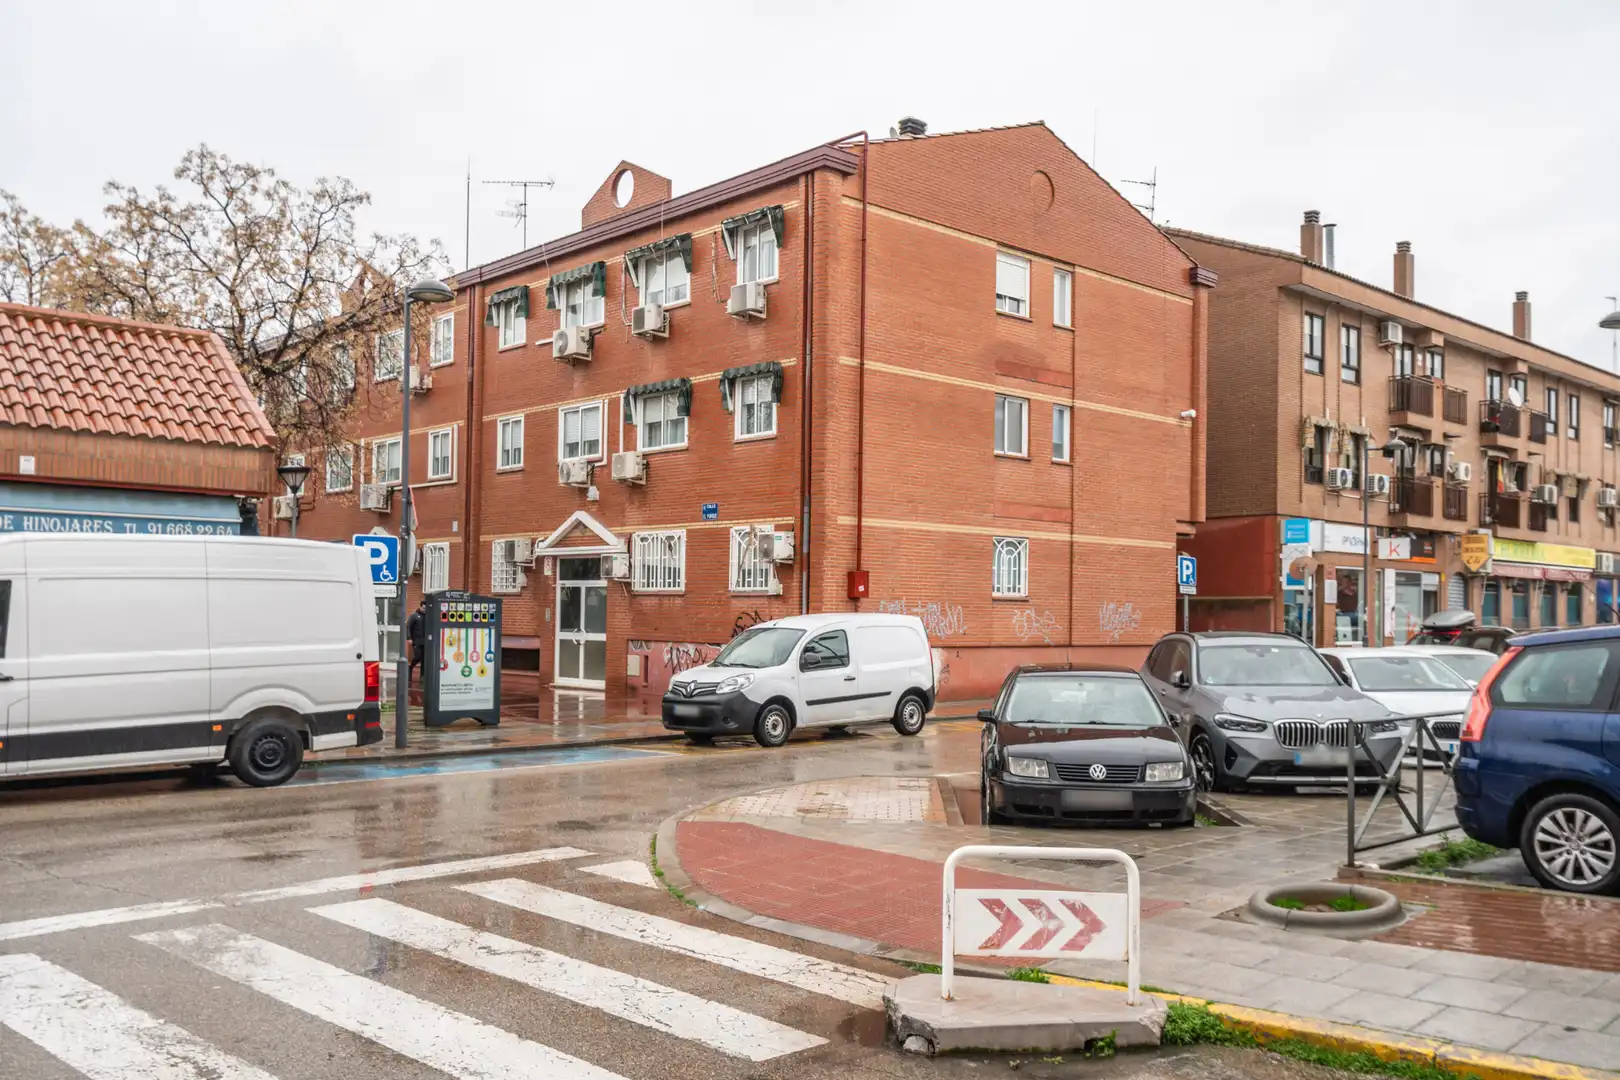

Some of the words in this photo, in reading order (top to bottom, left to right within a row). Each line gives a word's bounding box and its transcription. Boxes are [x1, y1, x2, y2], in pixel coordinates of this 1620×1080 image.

[23, 516, 113, 533] HINOJARES
[364, 541, 389, 565] P
[1183, 560, 1193, 582] P
